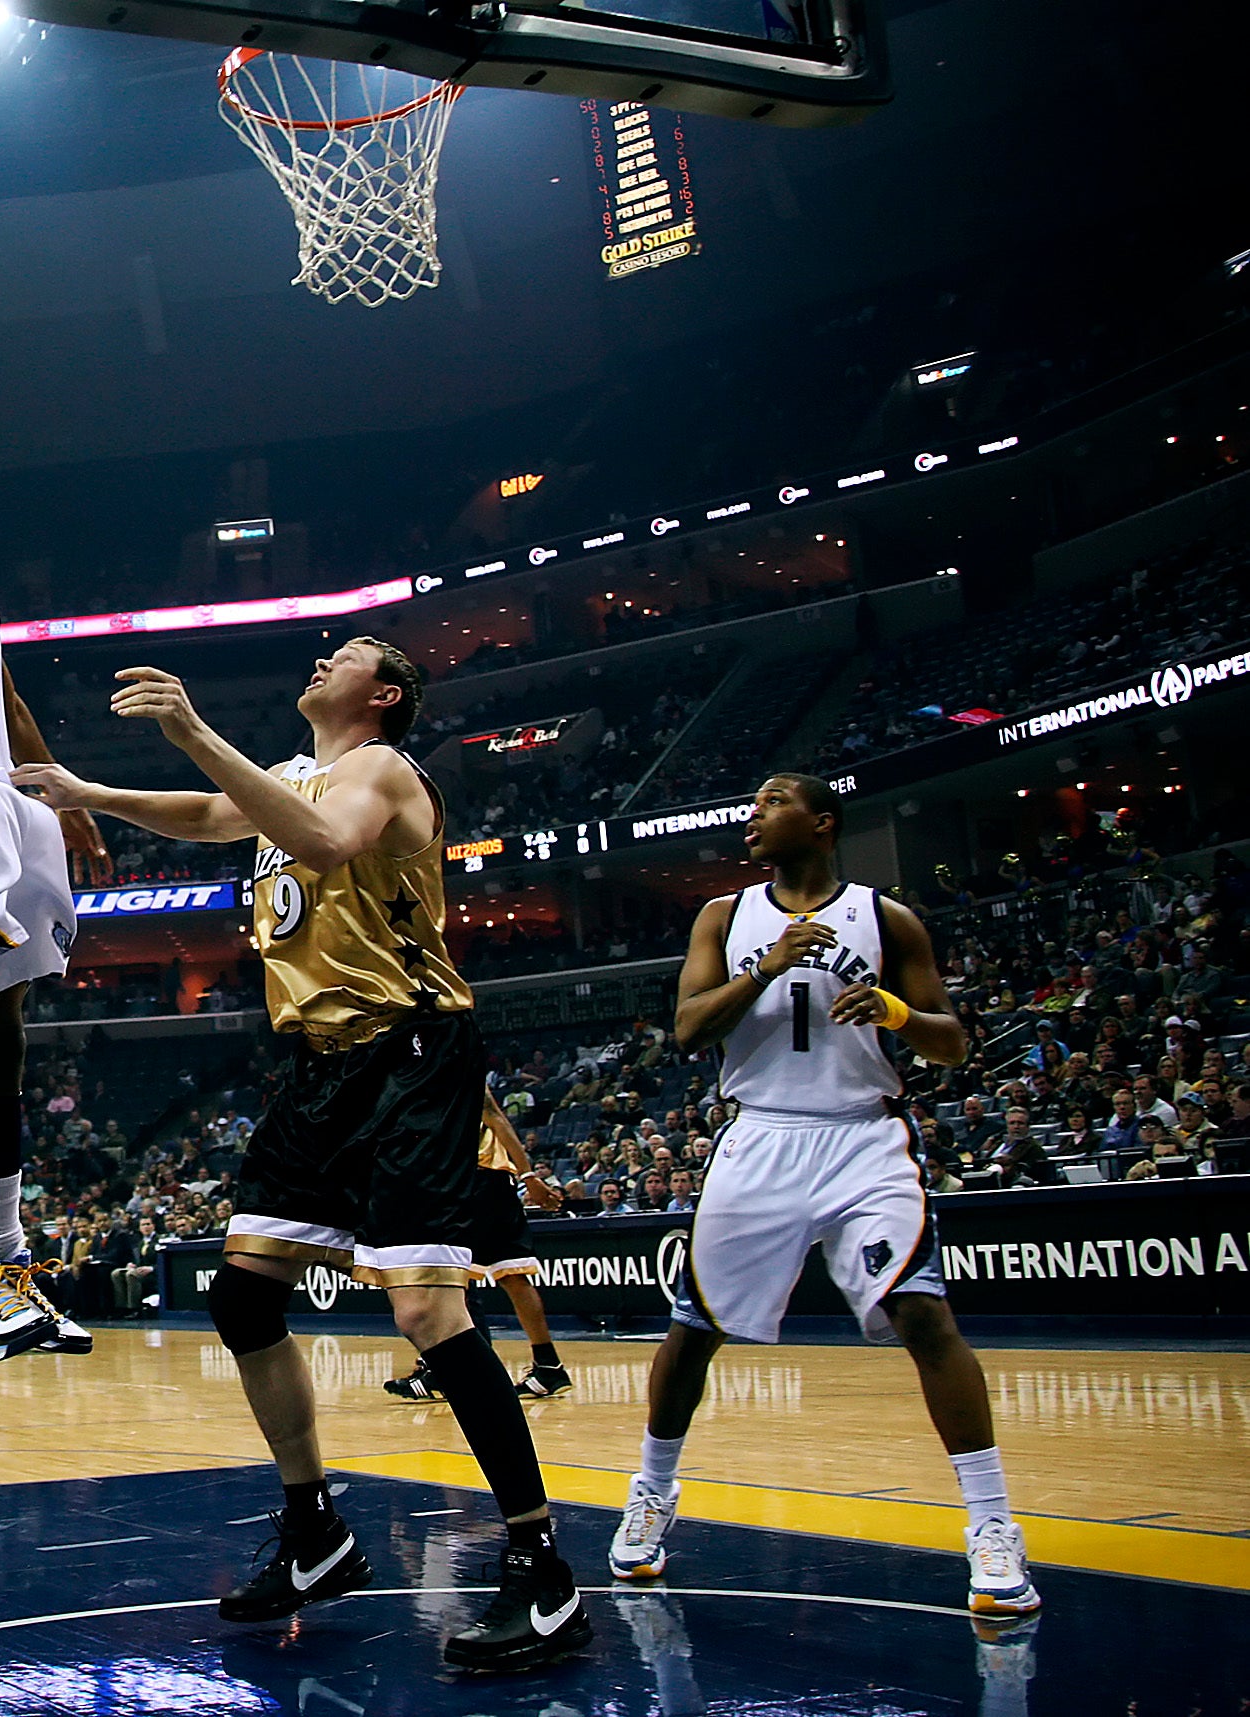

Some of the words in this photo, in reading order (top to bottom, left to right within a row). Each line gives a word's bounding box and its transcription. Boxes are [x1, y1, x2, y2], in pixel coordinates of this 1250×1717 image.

[616, 124, 651, 144] STEALS
[601, 237, 642, 264] GOLD
[642, 222, 695, 250] STRIKE
[612, 256, 649, 274] CASINO
[650, 244, 687, 263] RESORT
[998, 685, 1152, 746] INTERNATIONAL
[633, 803, 755, 839] INTERNATIO
[829, 775, 857, 796] PER
[447, 838, 504, 861] WIZARDS
[75, 885, 222, 915] LIGHT
[271, 872, 306, 940] 9
[790, 982, 810, 1052] 1
